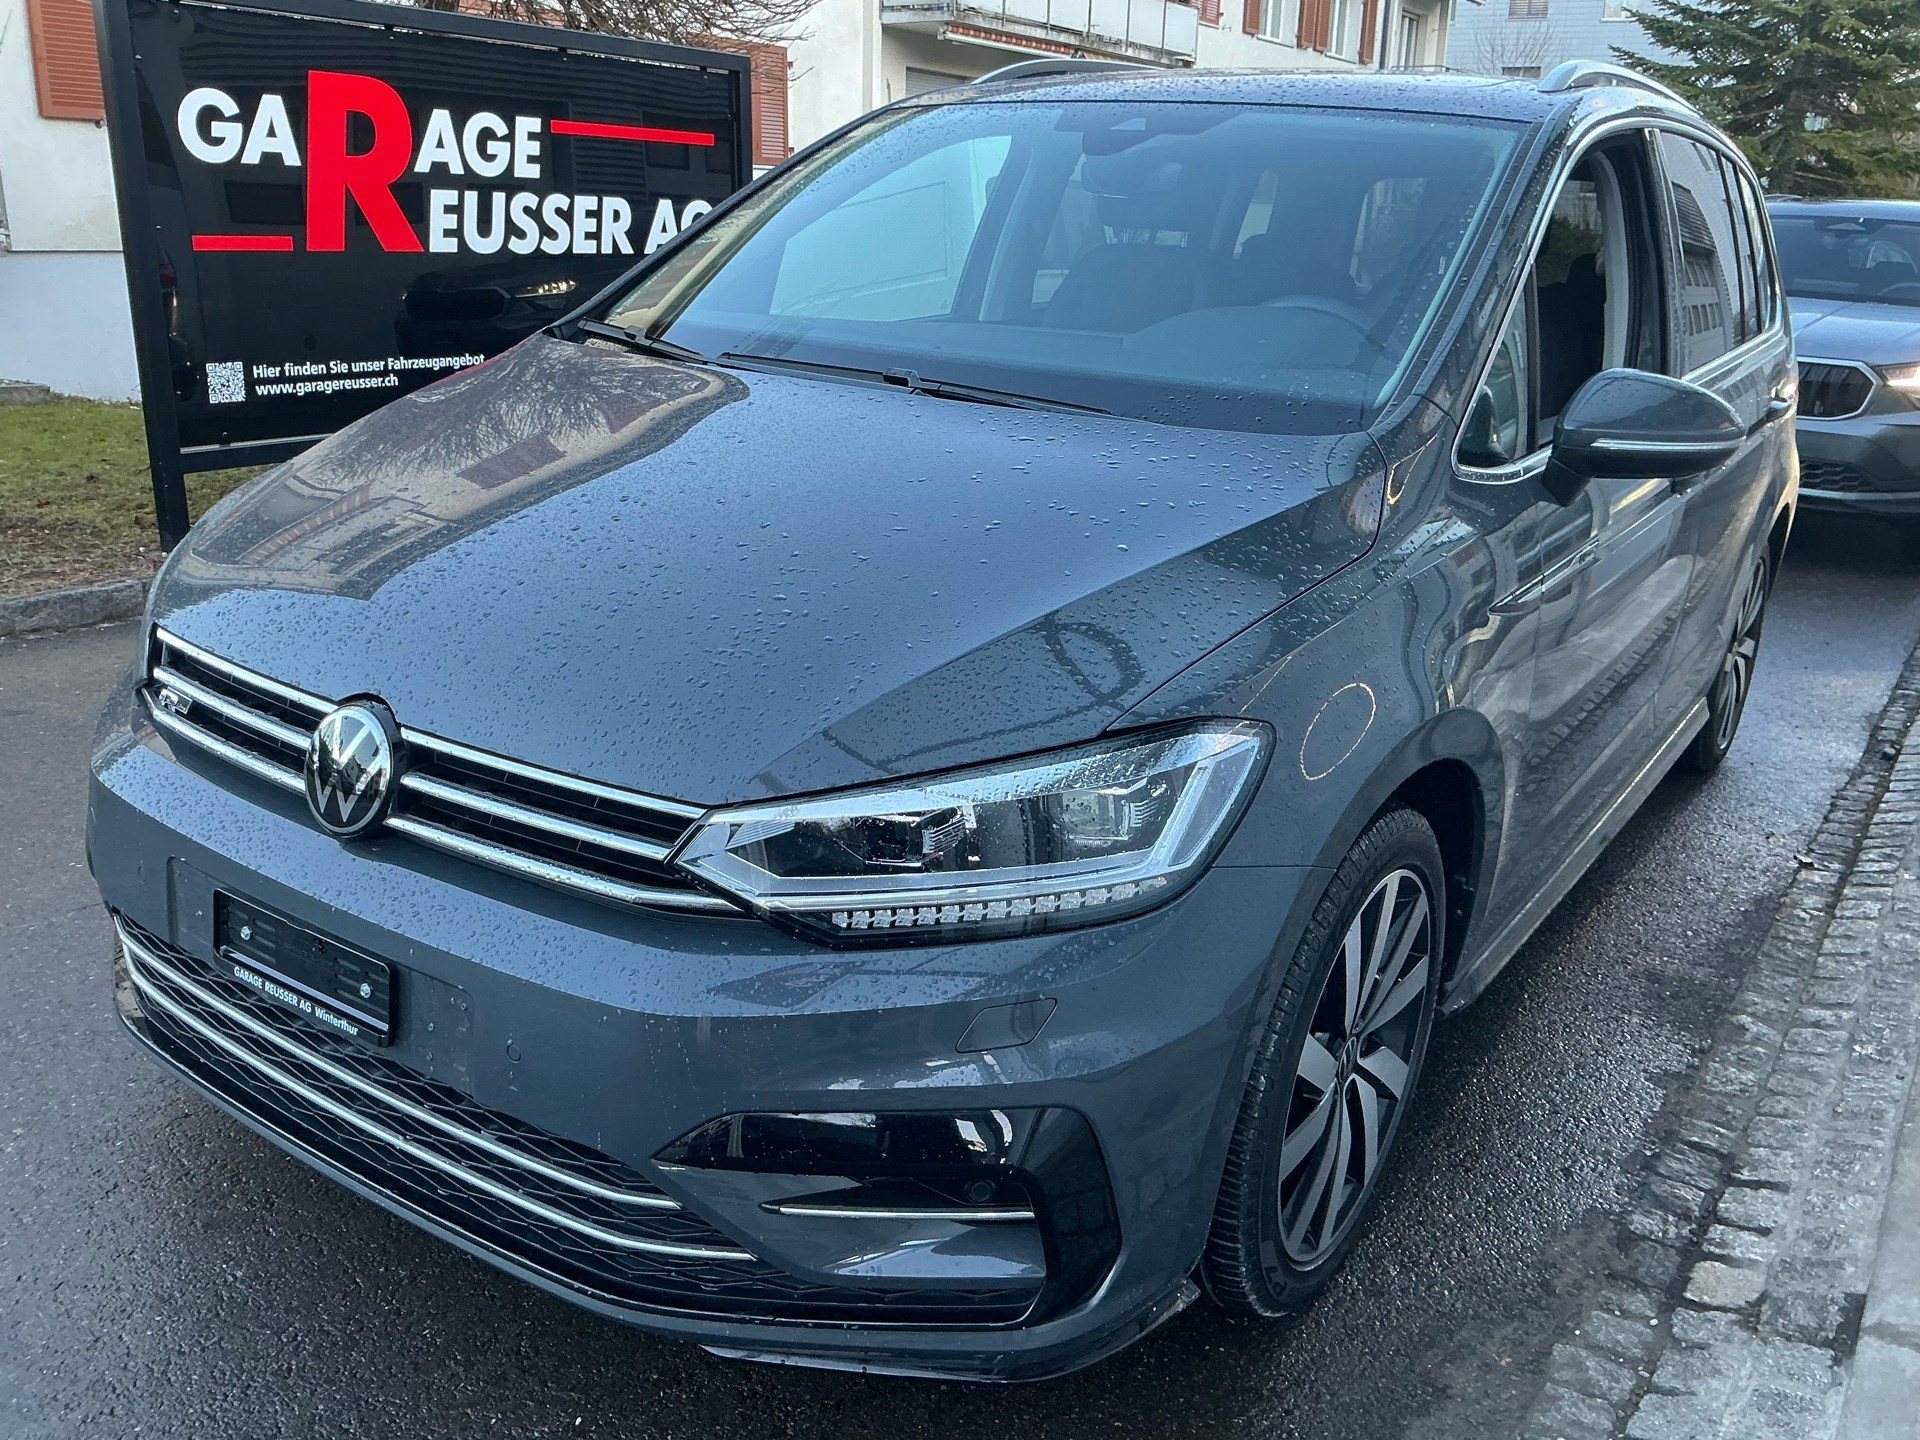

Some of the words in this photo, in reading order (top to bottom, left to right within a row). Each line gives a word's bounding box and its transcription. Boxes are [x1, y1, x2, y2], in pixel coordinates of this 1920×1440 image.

[177, 69, 542, 252] GARAGE
[252, 364, 282, 379] Hier
[283, 361, 327, 377] finden
[329, 360, 349, 374] Sie
[351, 359, 386, 374] unser
[387, 352, 485, 371] Fahrzeugangebot
[255, 373, 399, 396] www.garagereusser.ch
[233, 965, 263, 989] GARAGE
[264, 981, 298, 1007] REUSSER
[299, 998, 312, 1013] AG
[314, 1006, 359, 1036] Winterthur
